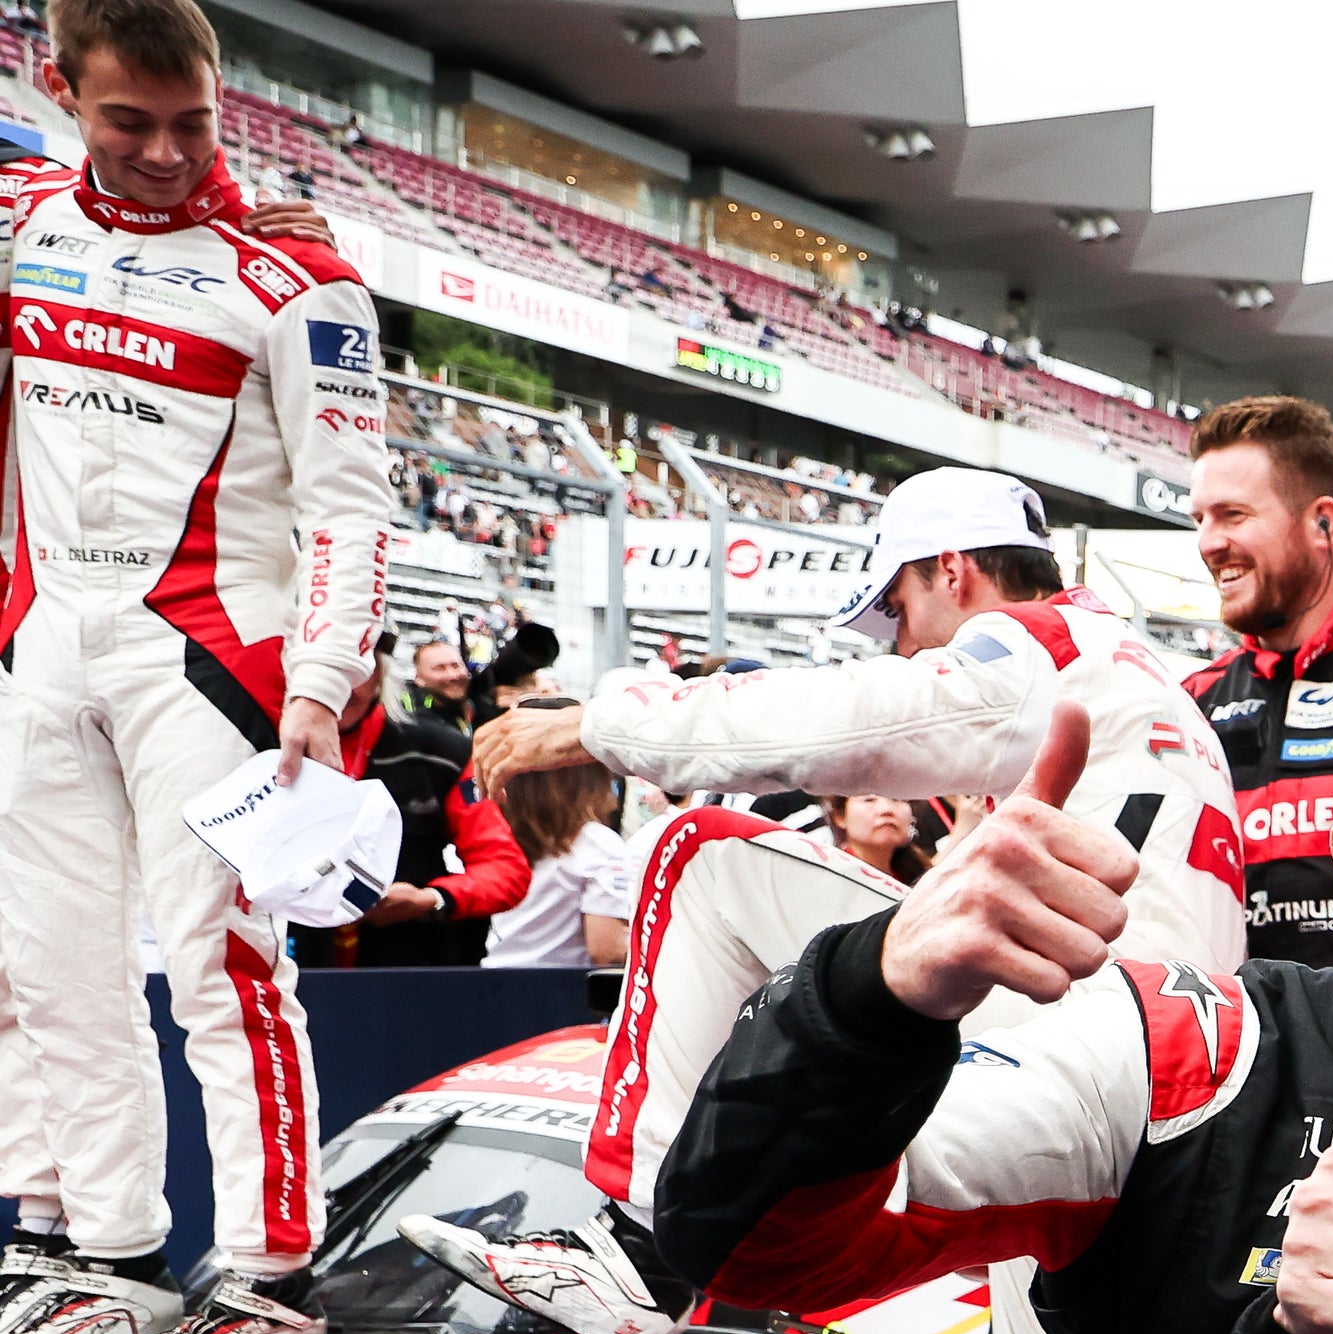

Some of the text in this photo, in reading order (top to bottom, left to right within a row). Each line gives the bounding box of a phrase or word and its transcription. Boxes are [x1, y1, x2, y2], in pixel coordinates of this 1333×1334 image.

[37, 233, 99, 255] WRT
[112, 256, 226, 293] WEC
[248, 258, 296, 299] OMP
[484, 284, 614, 344] DAIHATSU
[64, 319, 176, 371] ORLEN
[26, 384, 164, 424] REMUS
